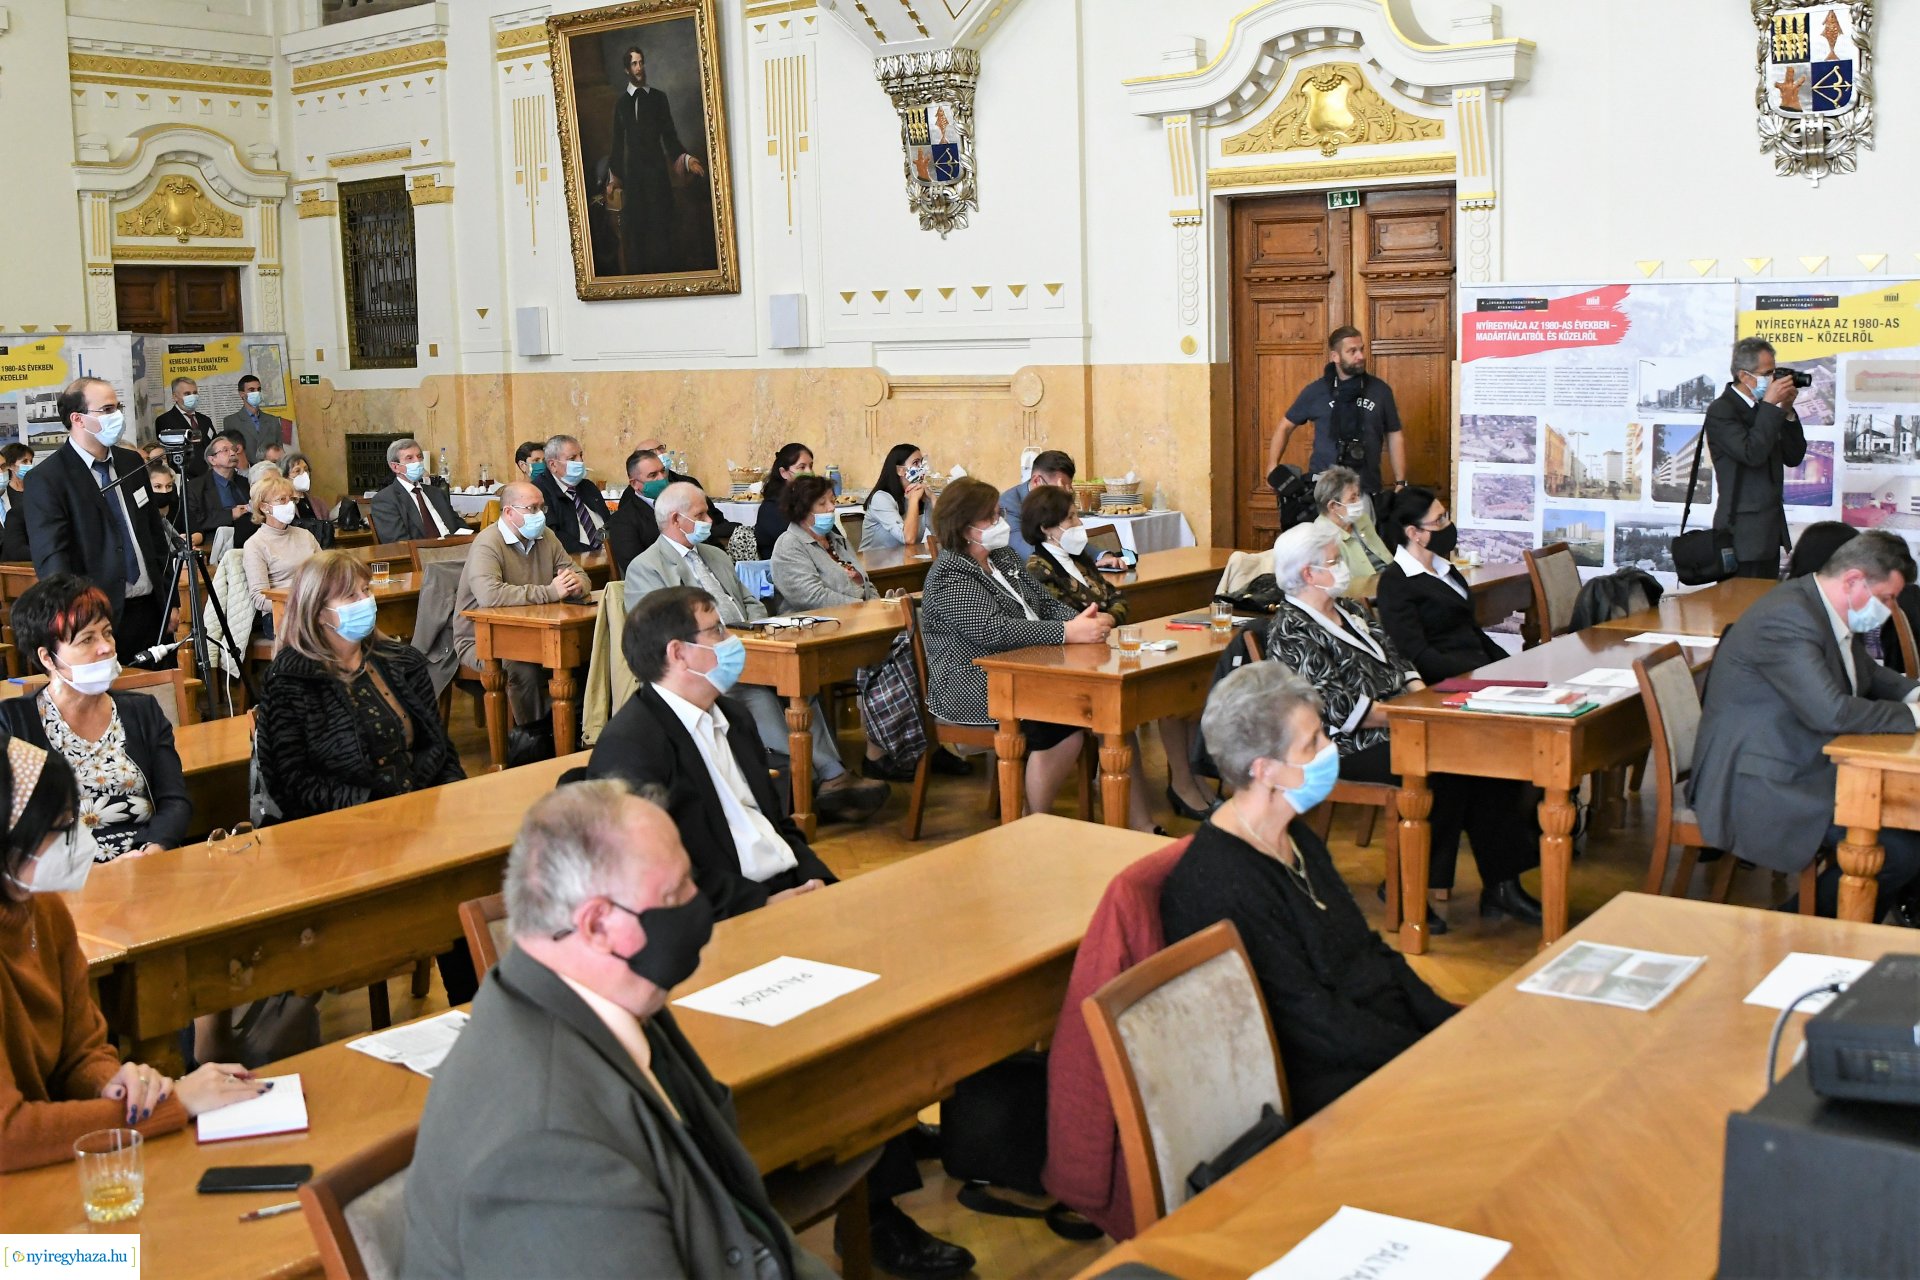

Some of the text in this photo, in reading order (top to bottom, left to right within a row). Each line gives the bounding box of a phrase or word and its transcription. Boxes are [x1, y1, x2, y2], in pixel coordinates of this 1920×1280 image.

[1476, 319, 1528, 330] NYÍREGYHÁZA
[1529, 321, 1539, 330] AZ
[1541, 320, 1573, 330] 1980-AS
[1574, 318, 1609, 330] ÉVEKBEN
[1756, 316, 1900, 329] NYÍREGYHÁZA AZ 1980-AS
[1476, 331, 1545, 341] MADÁRTÁVLATBÓL
[1547, 331, 1558, 341] ÉS
[1, 363, 54, 373] 1980-AS ÉVEKBEN
